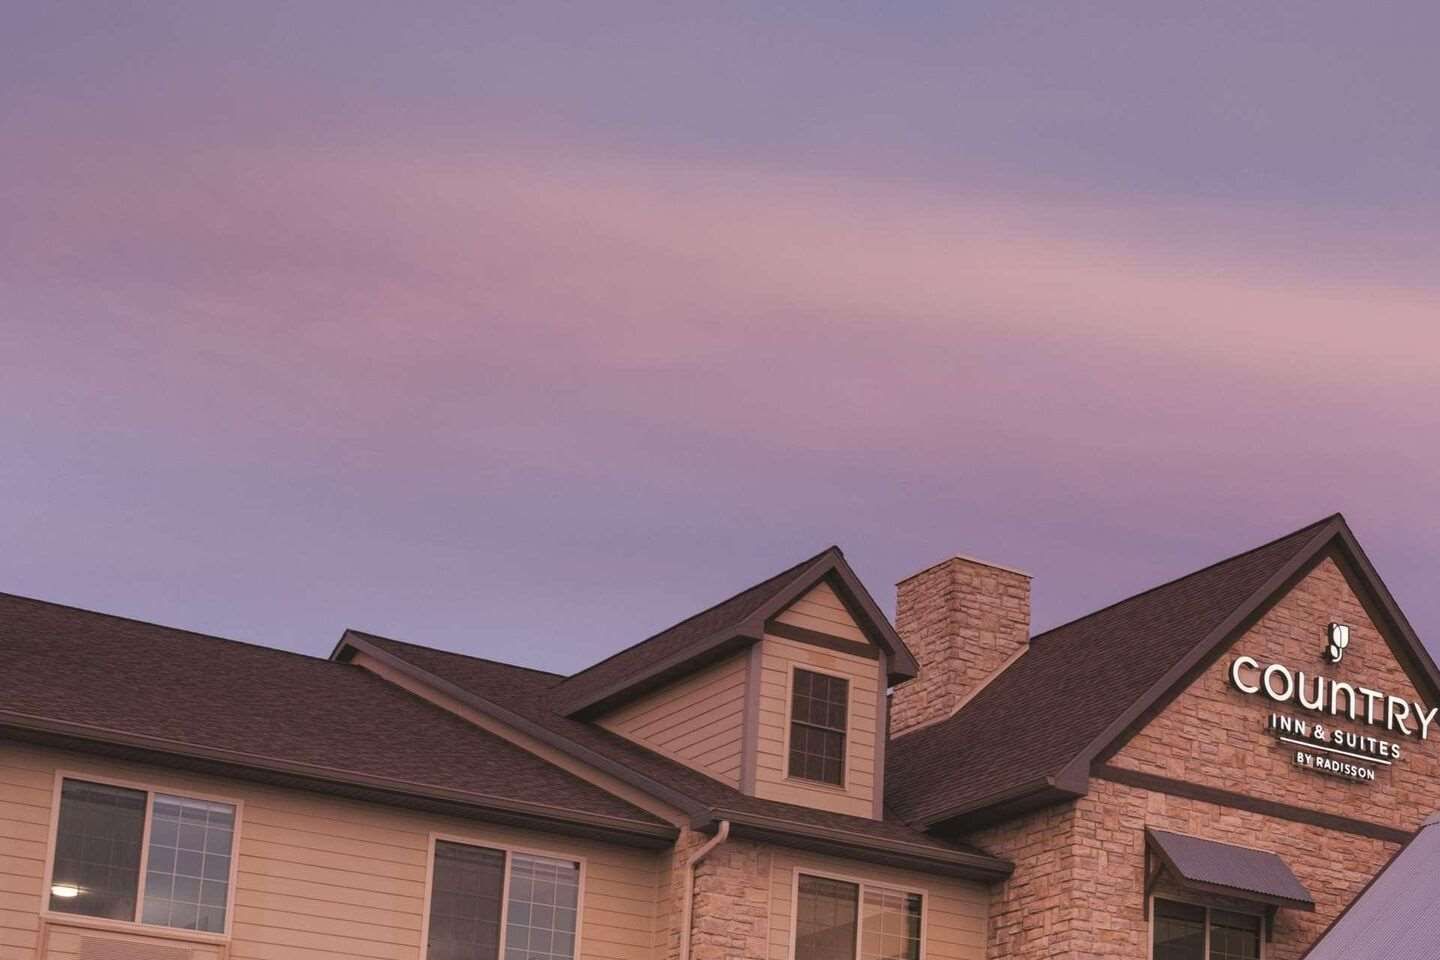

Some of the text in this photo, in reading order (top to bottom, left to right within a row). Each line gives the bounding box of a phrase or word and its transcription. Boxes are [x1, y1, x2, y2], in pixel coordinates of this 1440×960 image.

[1272, 713, 1401, 759] INN & SUITES
[1296, 751, 1375, 780] BY RADISSON
